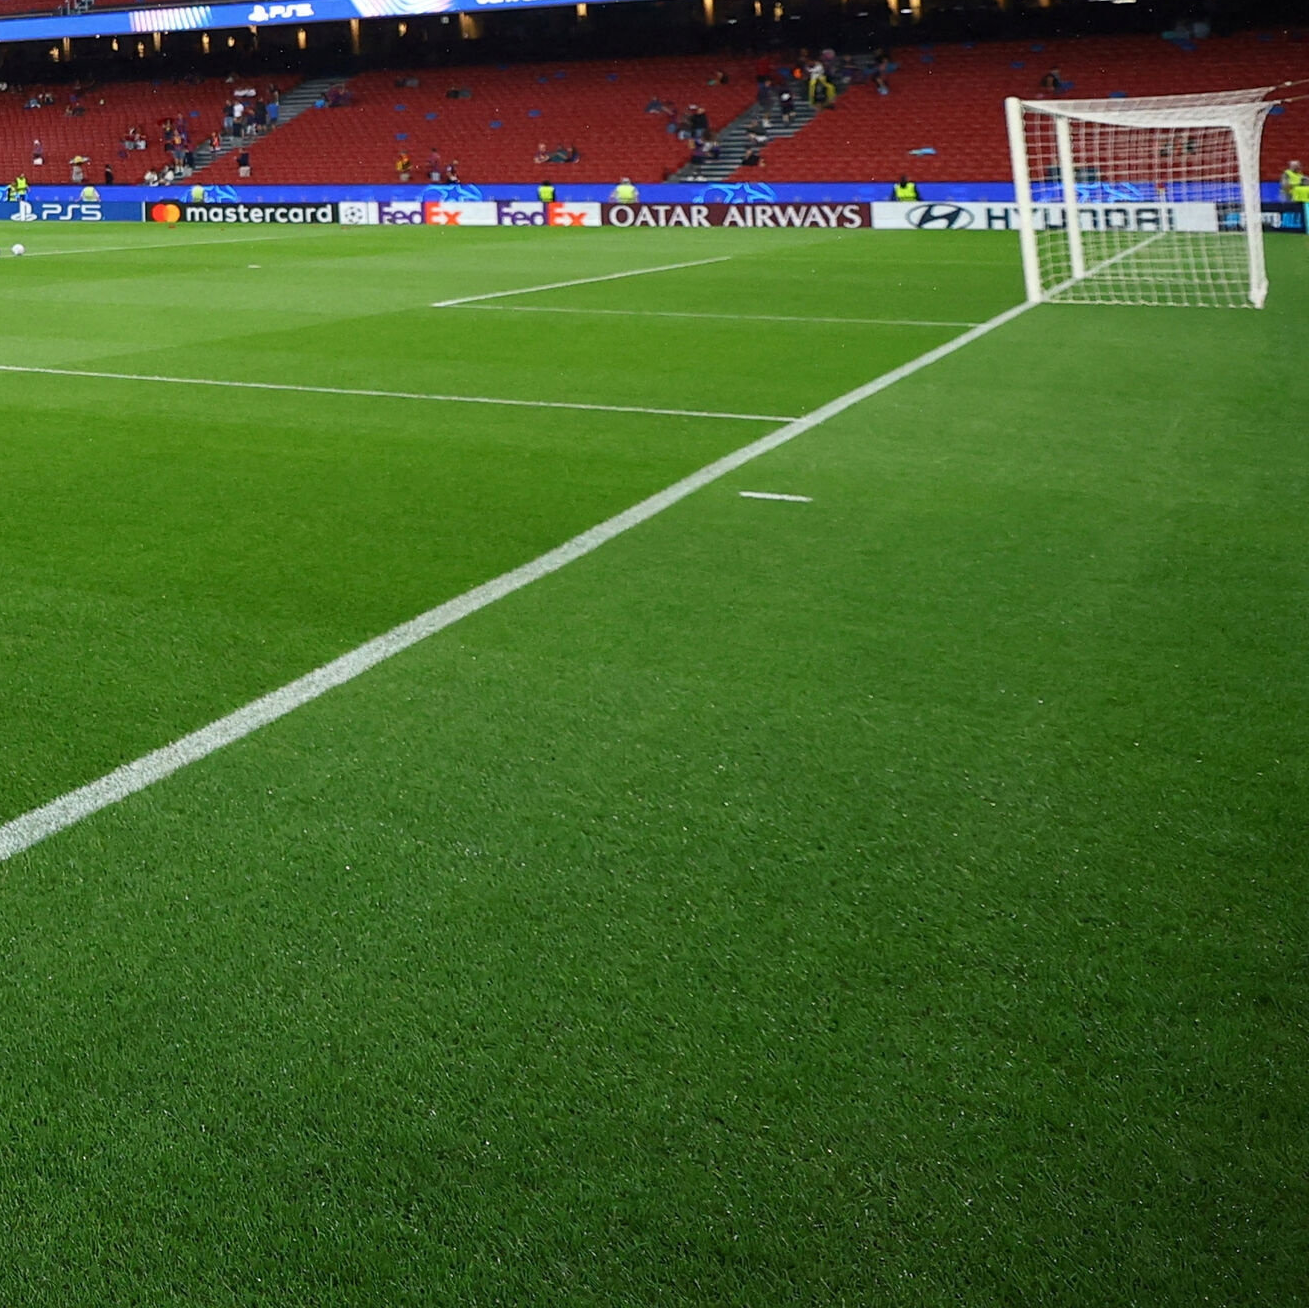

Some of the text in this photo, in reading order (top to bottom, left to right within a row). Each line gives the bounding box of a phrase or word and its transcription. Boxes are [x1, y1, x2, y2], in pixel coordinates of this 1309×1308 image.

[42, 204, 102, 220] PS5
[186, 204, 333, 222] mastercard
[379, 202, 463, 225] FedEx
[497, 202, 587, 226] FedEx
[609, 204, 862, 228] QATAR AIRWAYS
